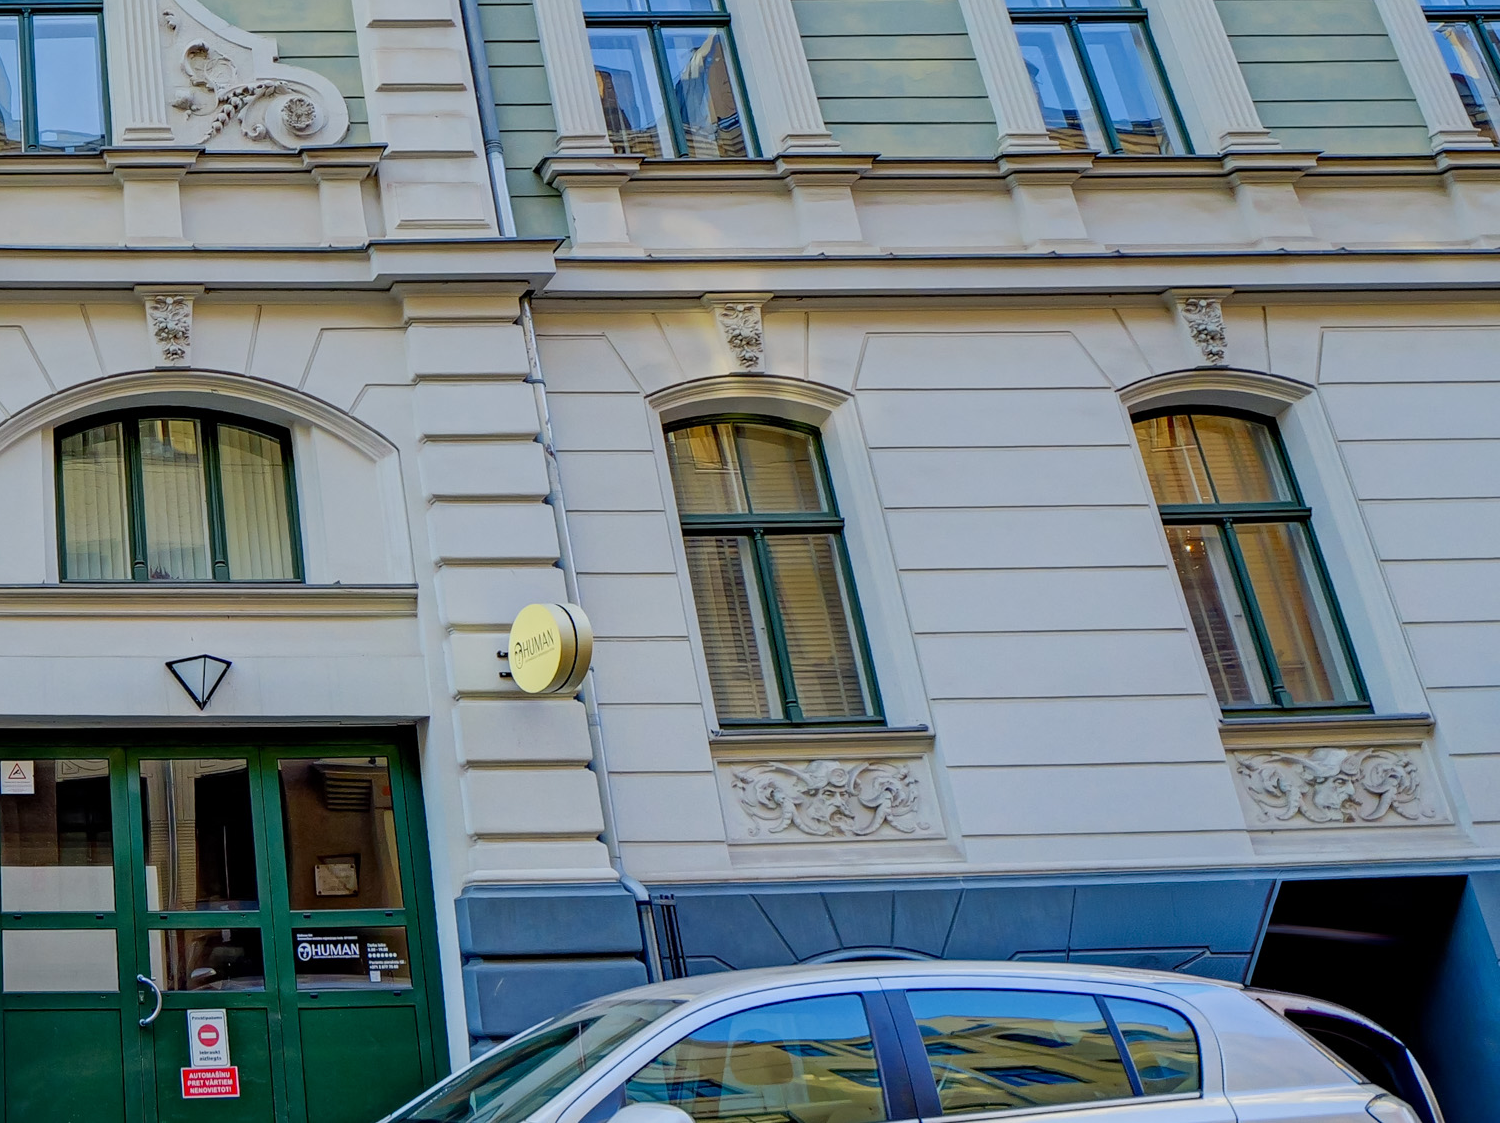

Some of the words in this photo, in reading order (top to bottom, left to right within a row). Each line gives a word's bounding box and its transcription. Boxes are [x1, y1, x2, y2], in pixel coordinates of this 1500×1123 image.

[522, 628, 555, 658] HUMAN
[312, 943, 360, 956] HUMAN
[189, 1071, 231, 1079] AUTOMAŠĪNU
[187, 1079, 204, 1087] PRET
[205, 1078, 234, 1086] VĀRTIEM
